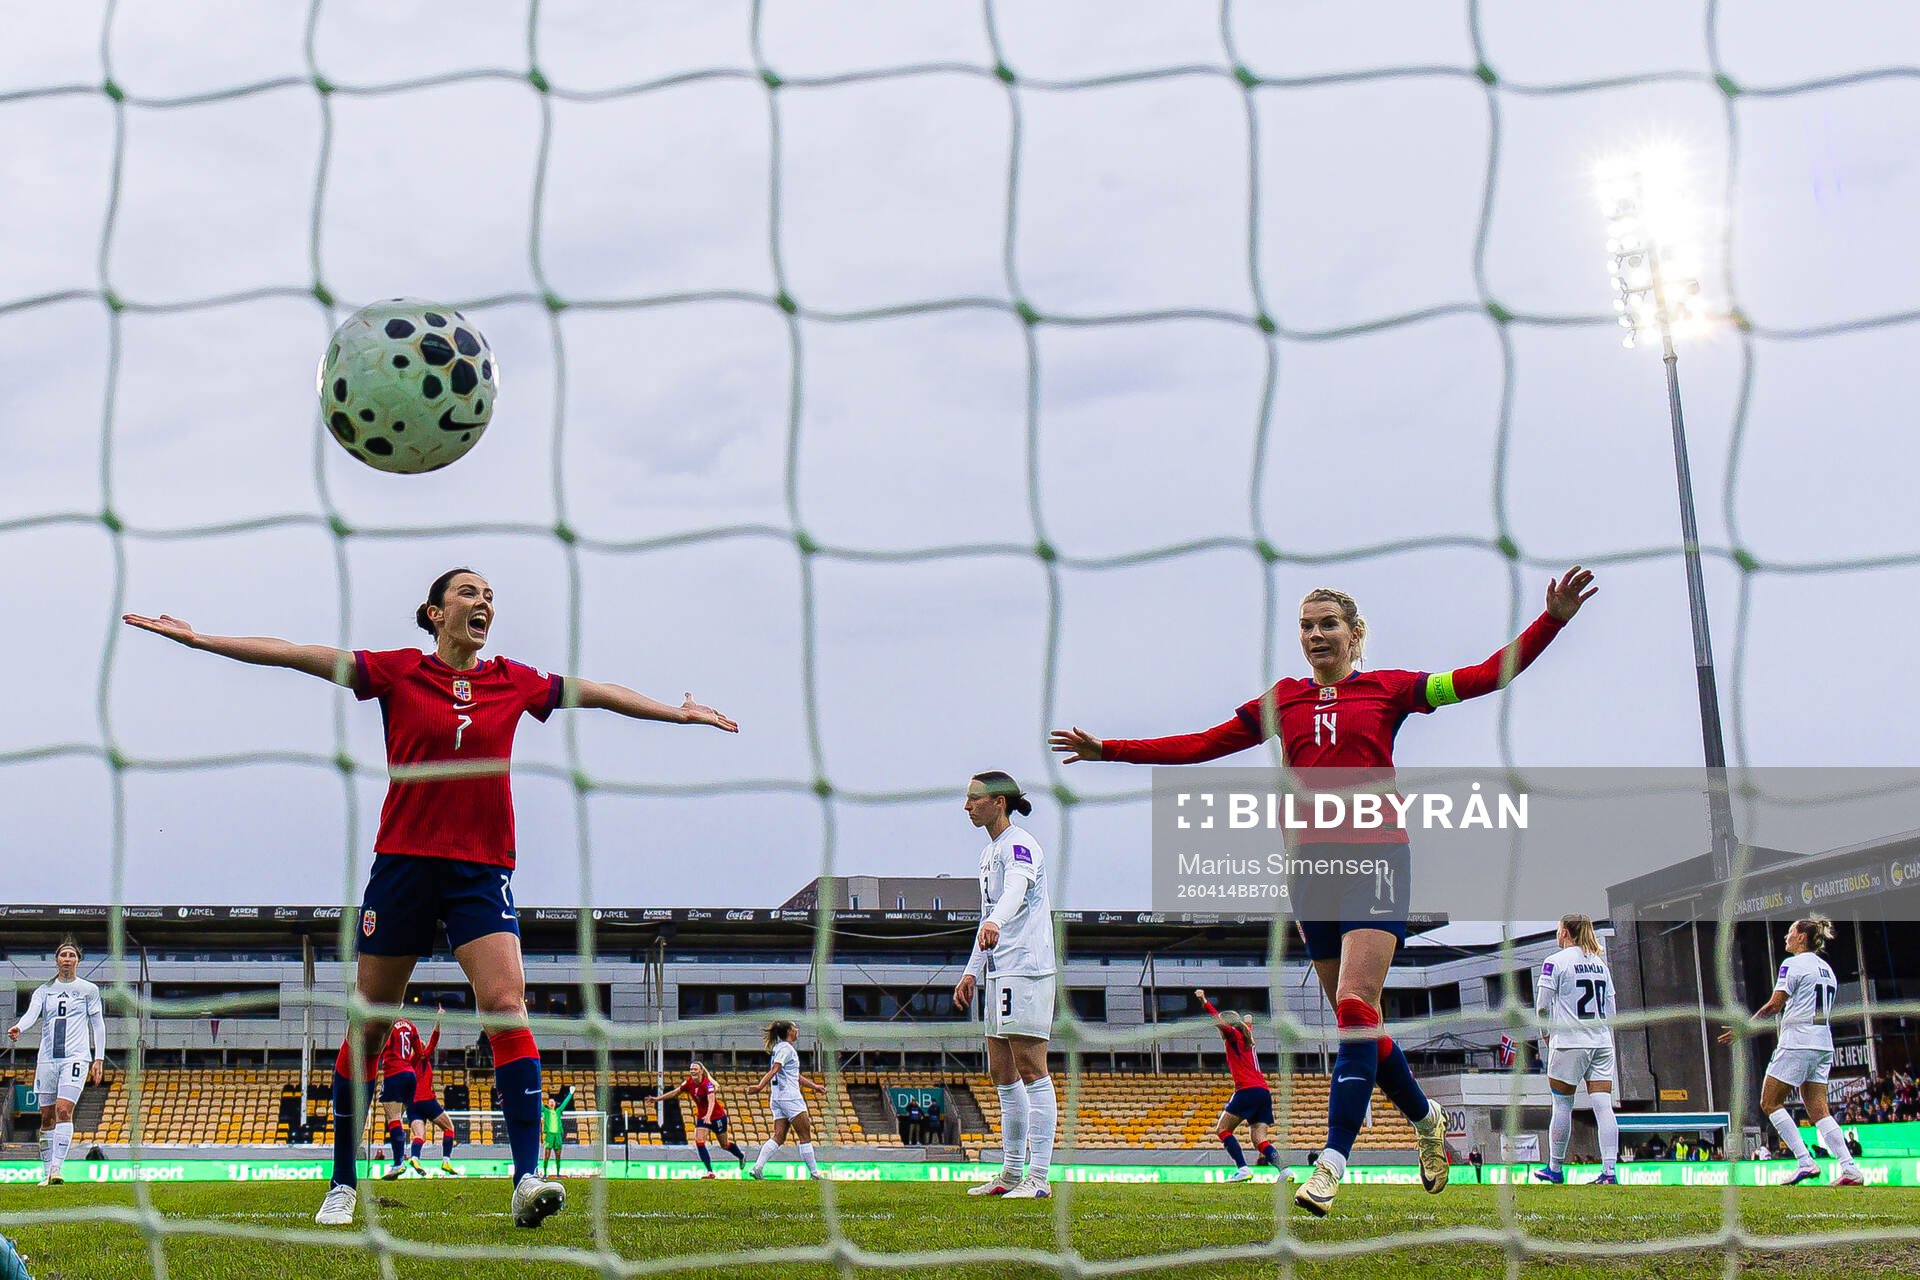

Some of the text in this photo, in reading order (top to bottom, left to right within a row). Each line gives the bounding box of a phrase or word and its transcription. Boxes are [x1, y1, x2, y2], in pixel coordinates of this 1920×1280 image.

[455, 714, 473, 751] 7
[1313, 712, 1337, 747] 14
[500, 874, 510, 907] 7
[57, 1000, 67, 1017] 6
[1001, 987, 1013, 1017] 3
[1576, 979, 1607, 1020] 20
[399, 1031, 411, 1060] 15
[72, 1062, 81, 1078] 6
[898, 1089, 932, 1109] DNB
[112, 1164, 183, 1182] unisport
[252, 1164, 323, 1180] unisport
[1088, 1169, 1159, 1183] unisport
[1630, 1167, 1662, 1184] unisport
[1694, 1166, 1729, 1185] unisport
